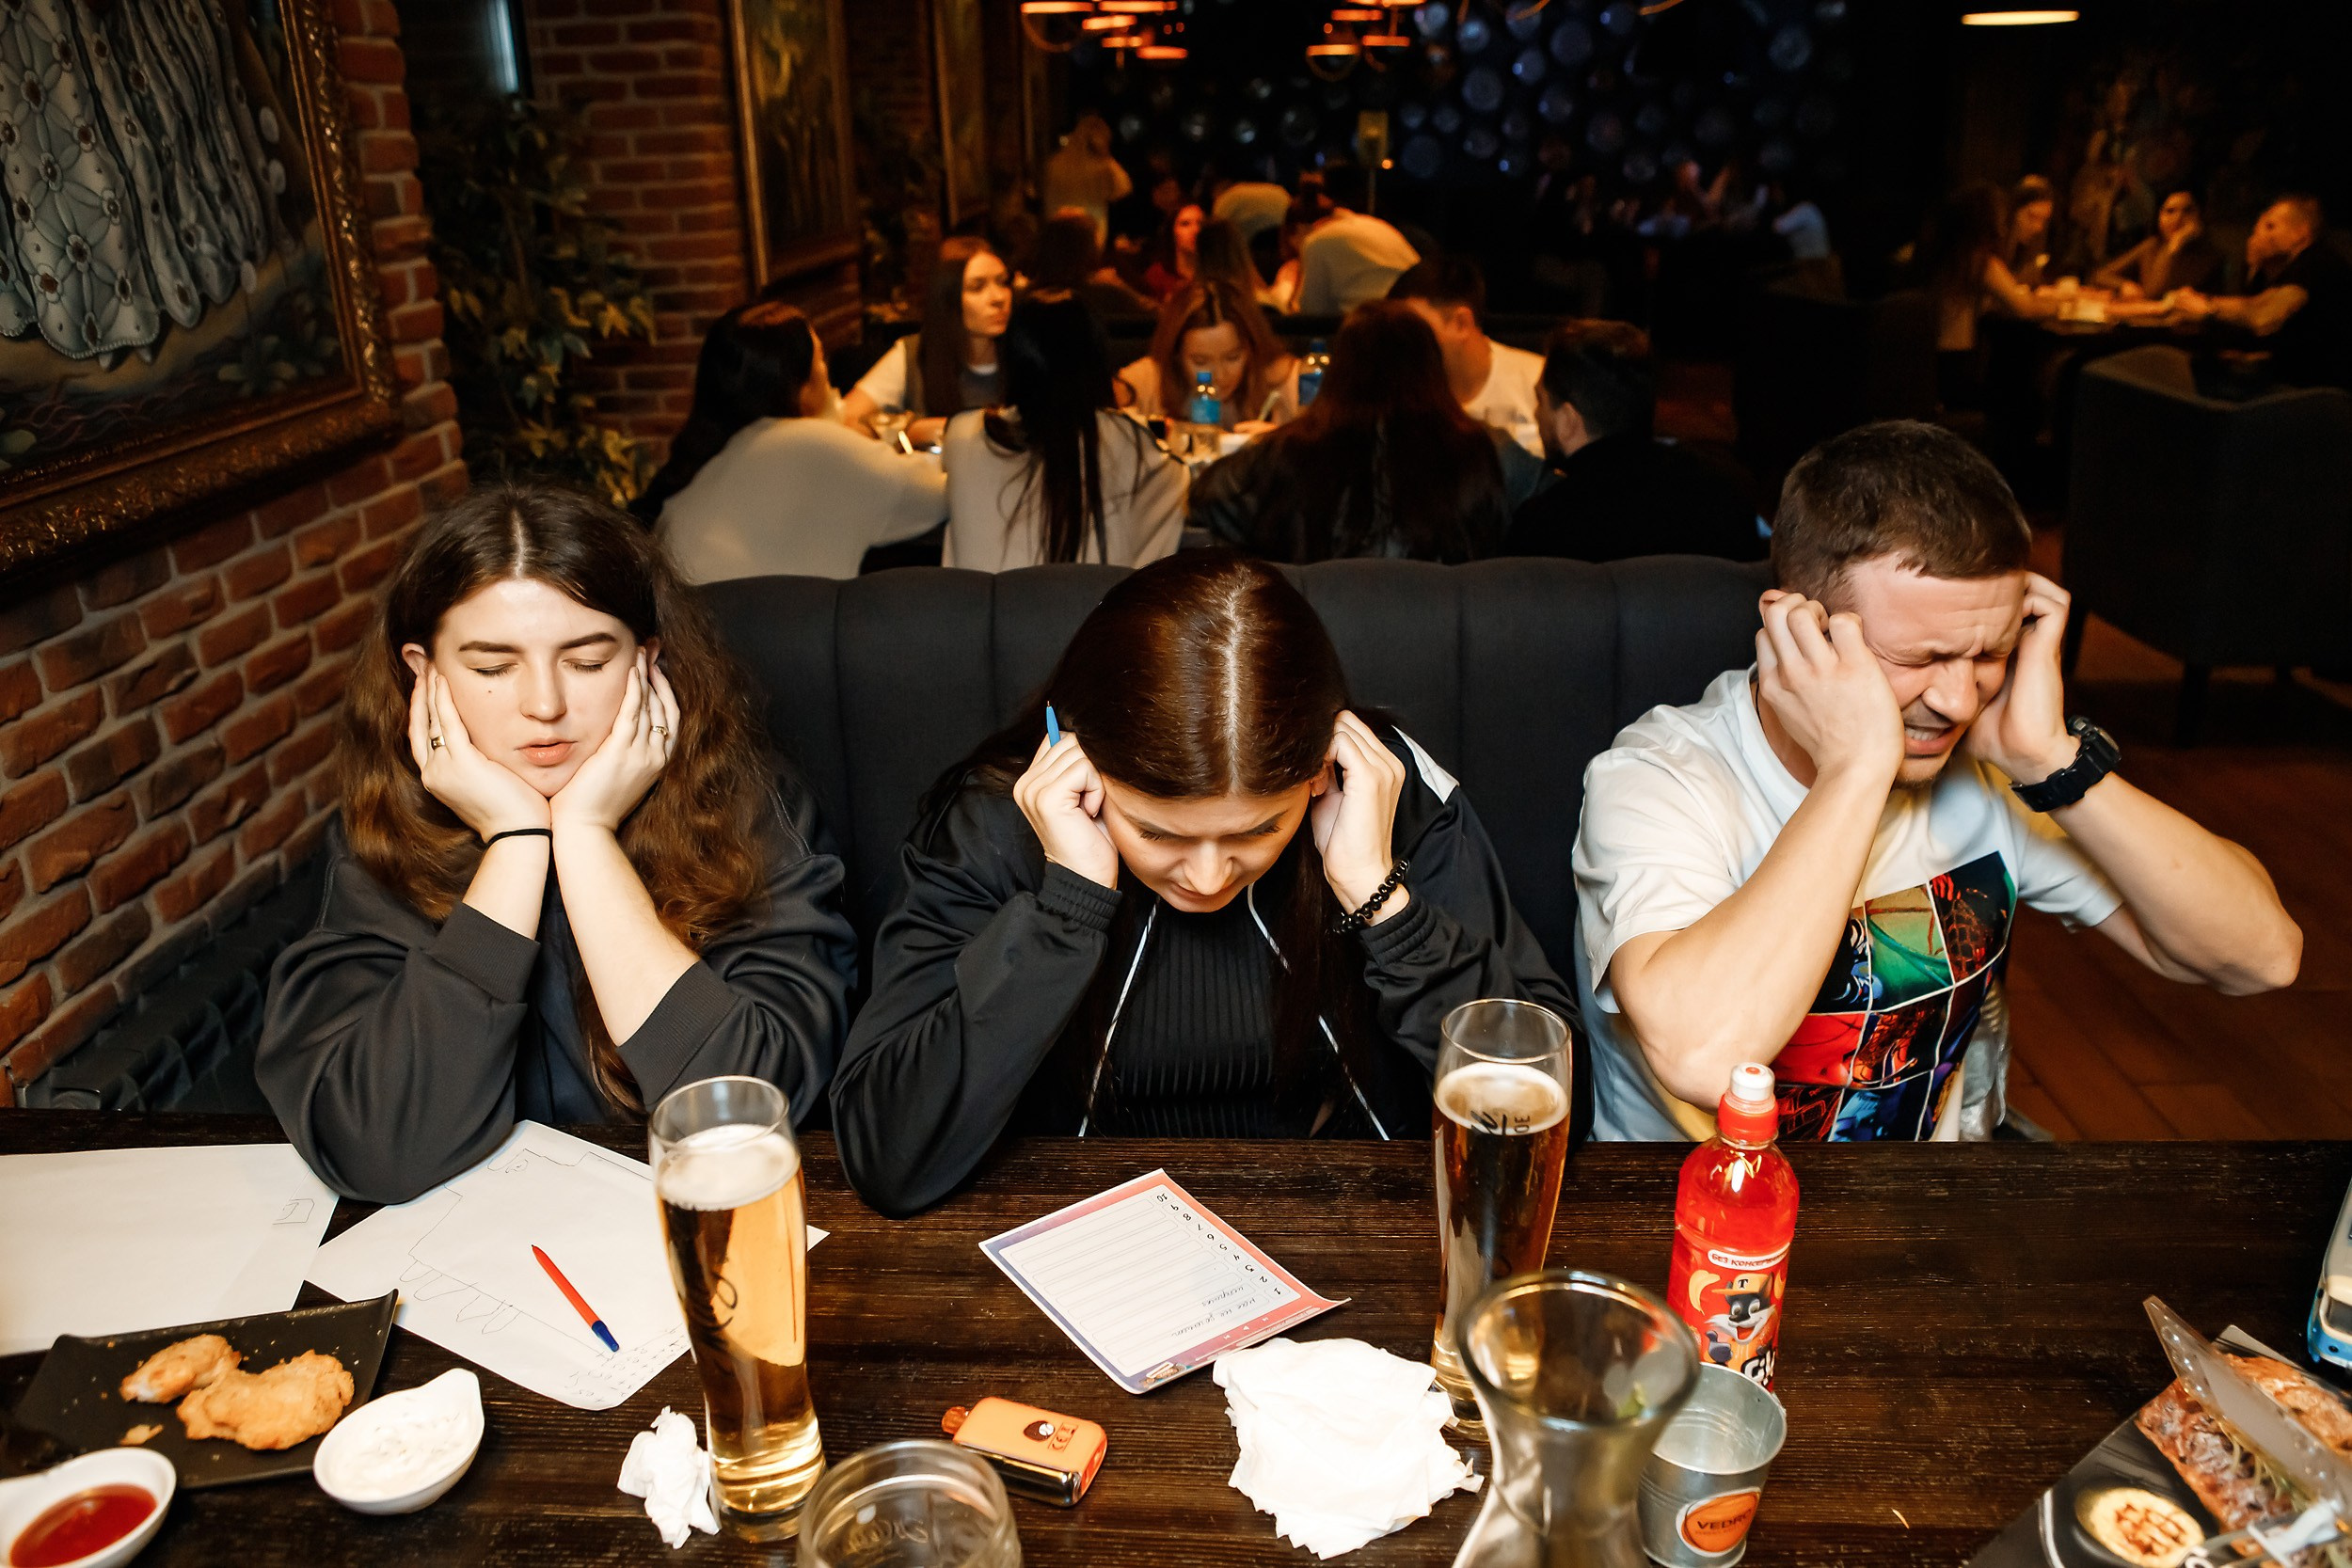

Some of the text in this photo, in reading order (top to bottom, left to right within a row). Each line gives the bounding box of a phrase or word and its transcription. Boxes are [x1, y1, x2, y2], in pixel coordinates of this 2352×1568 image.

[1156, 1193, 1168, 1203] 10
[1183, 1212, 1192, 1222] 8
[1206, 1233, 1215, 1242] 6
[1219, 1243, 1228, 1251] 5
[1233, 1253, 1240, 1261] 4
[1711, 1253, 1728, 1264] БЕЗ
[1245, 1264, 1255, 1274] 3
[1259, 1275, 1268, 1284] 2
[1273, 1287, 1281, 1296] 1
